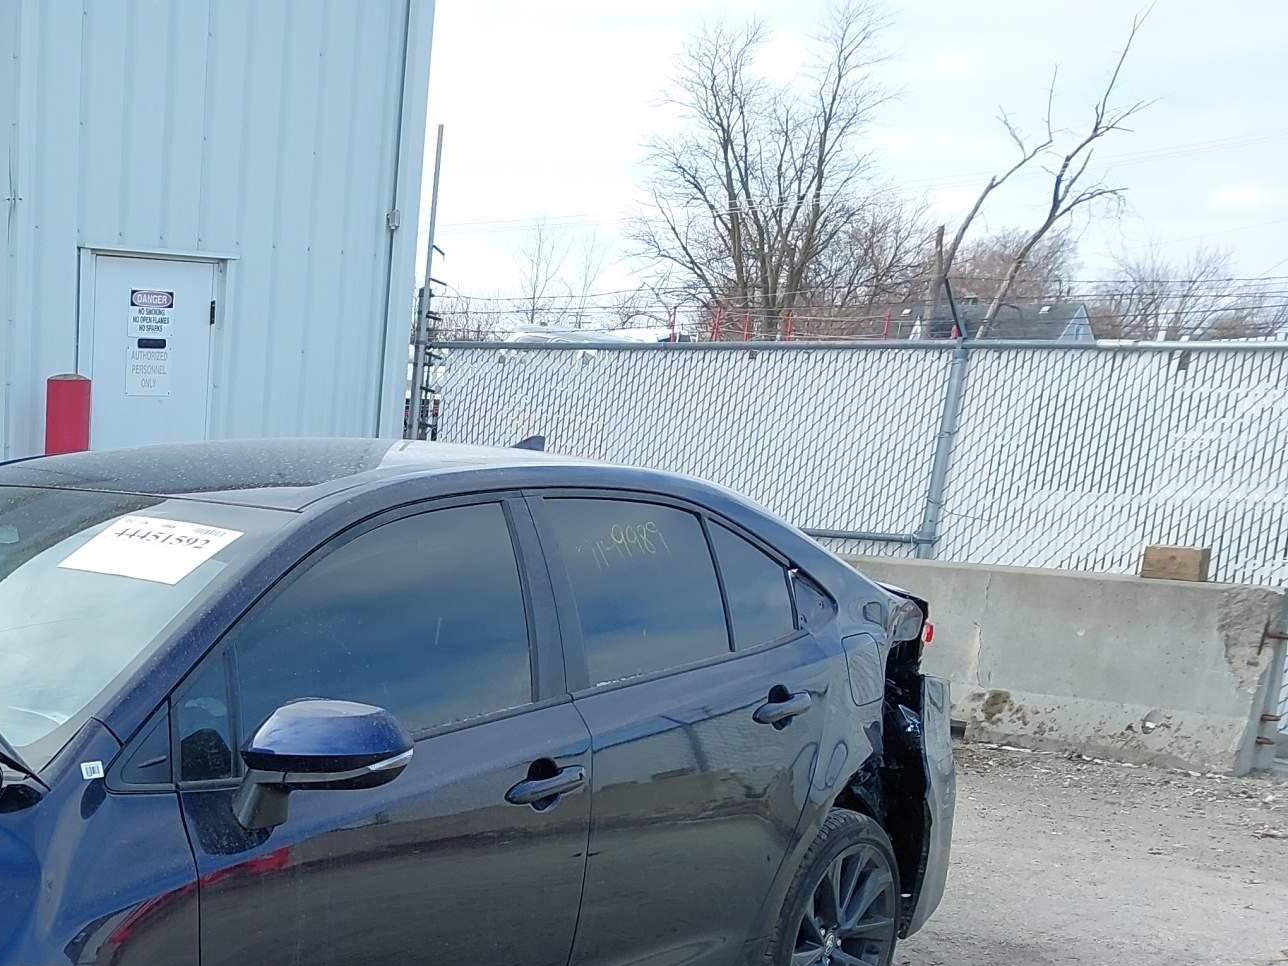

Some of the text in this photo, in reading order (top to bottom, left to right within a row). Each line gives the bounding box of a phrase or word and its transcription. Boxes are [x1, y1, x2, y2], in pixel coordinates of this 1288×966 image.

[137, 294, 168, 305] DANGER
[140, 316, 152, 324] OPEN
[153, 317, 170, 325] FLAMES
[131, 350, 168, 361] AUTHORIZED
[132, 364, 167, 375] PERSONNEL
[141, 378, 156, 389] ONLY
[114, 527, 211, 550] 44451592
